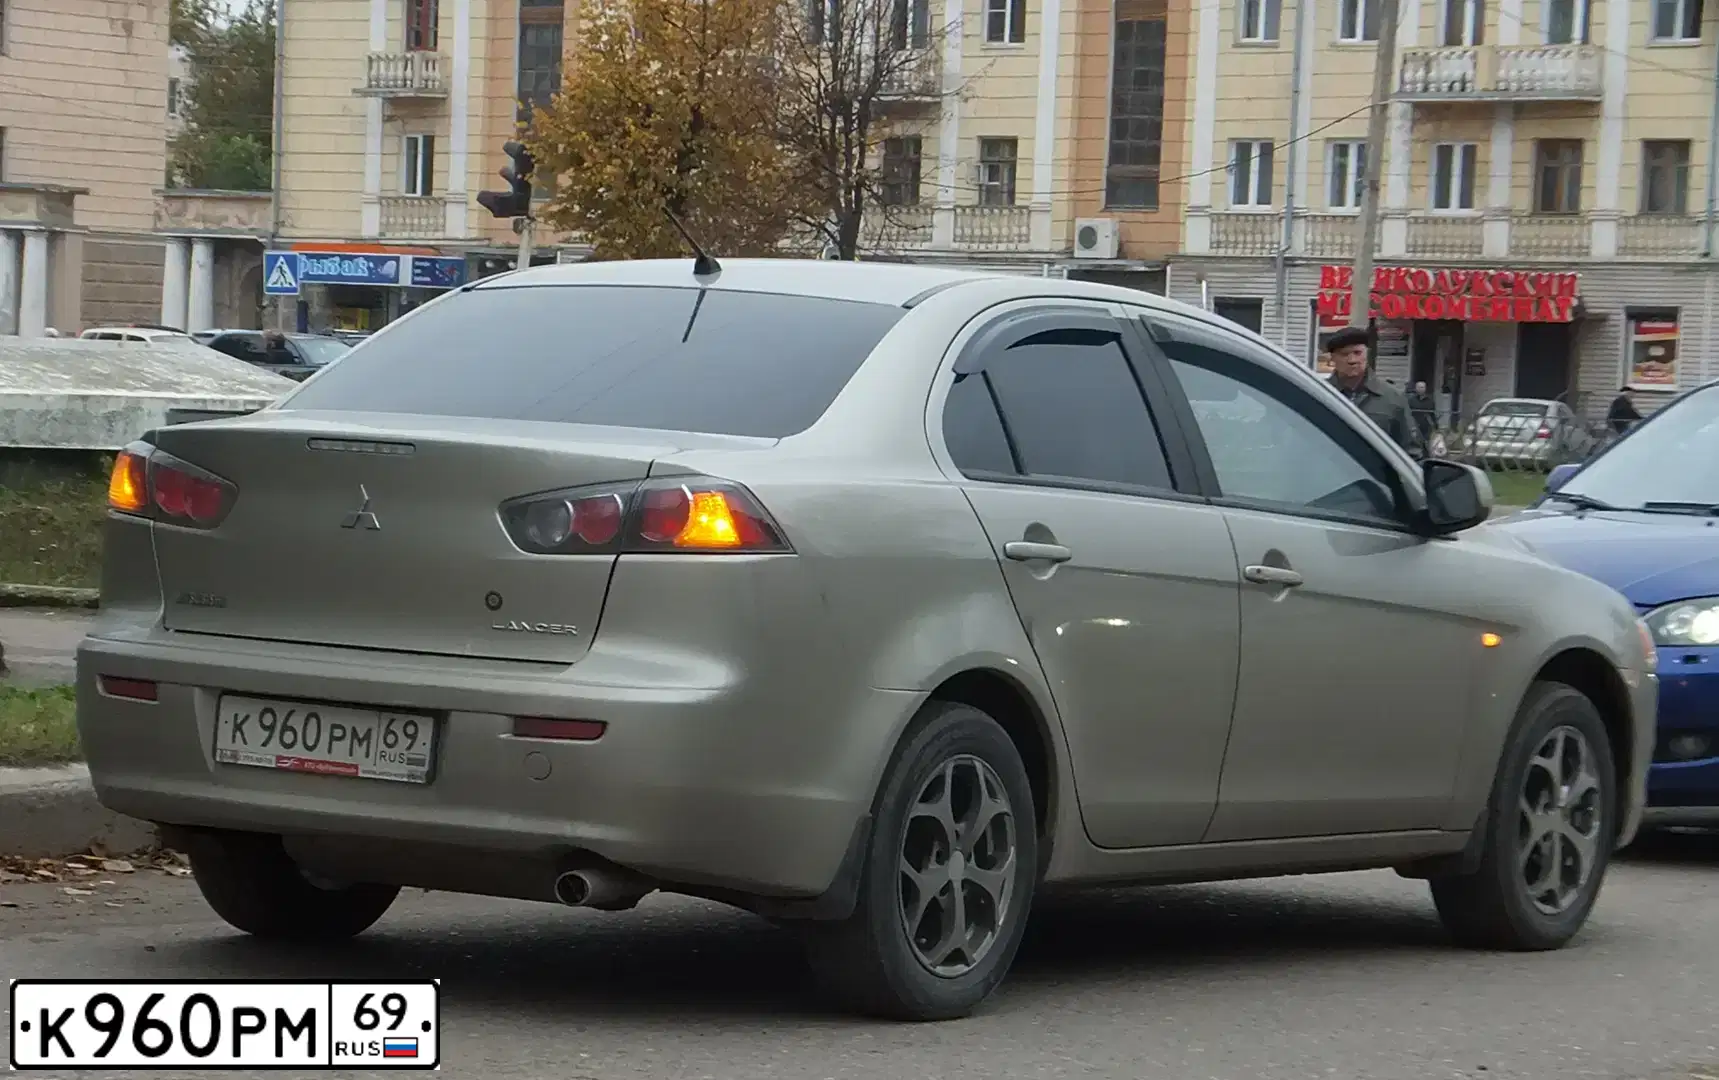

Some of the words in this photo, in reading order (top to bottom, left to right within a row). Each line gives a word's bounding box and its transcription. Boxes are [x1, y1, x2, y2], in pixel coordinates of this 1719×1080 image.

[1320, 265, 1582, 297] ВЕИКОЛУКСКИЙ
[492, 620, 579, 636] LANCER
[383, 718, 419, 750] 69
[379, 750, 406, 764] RUS
